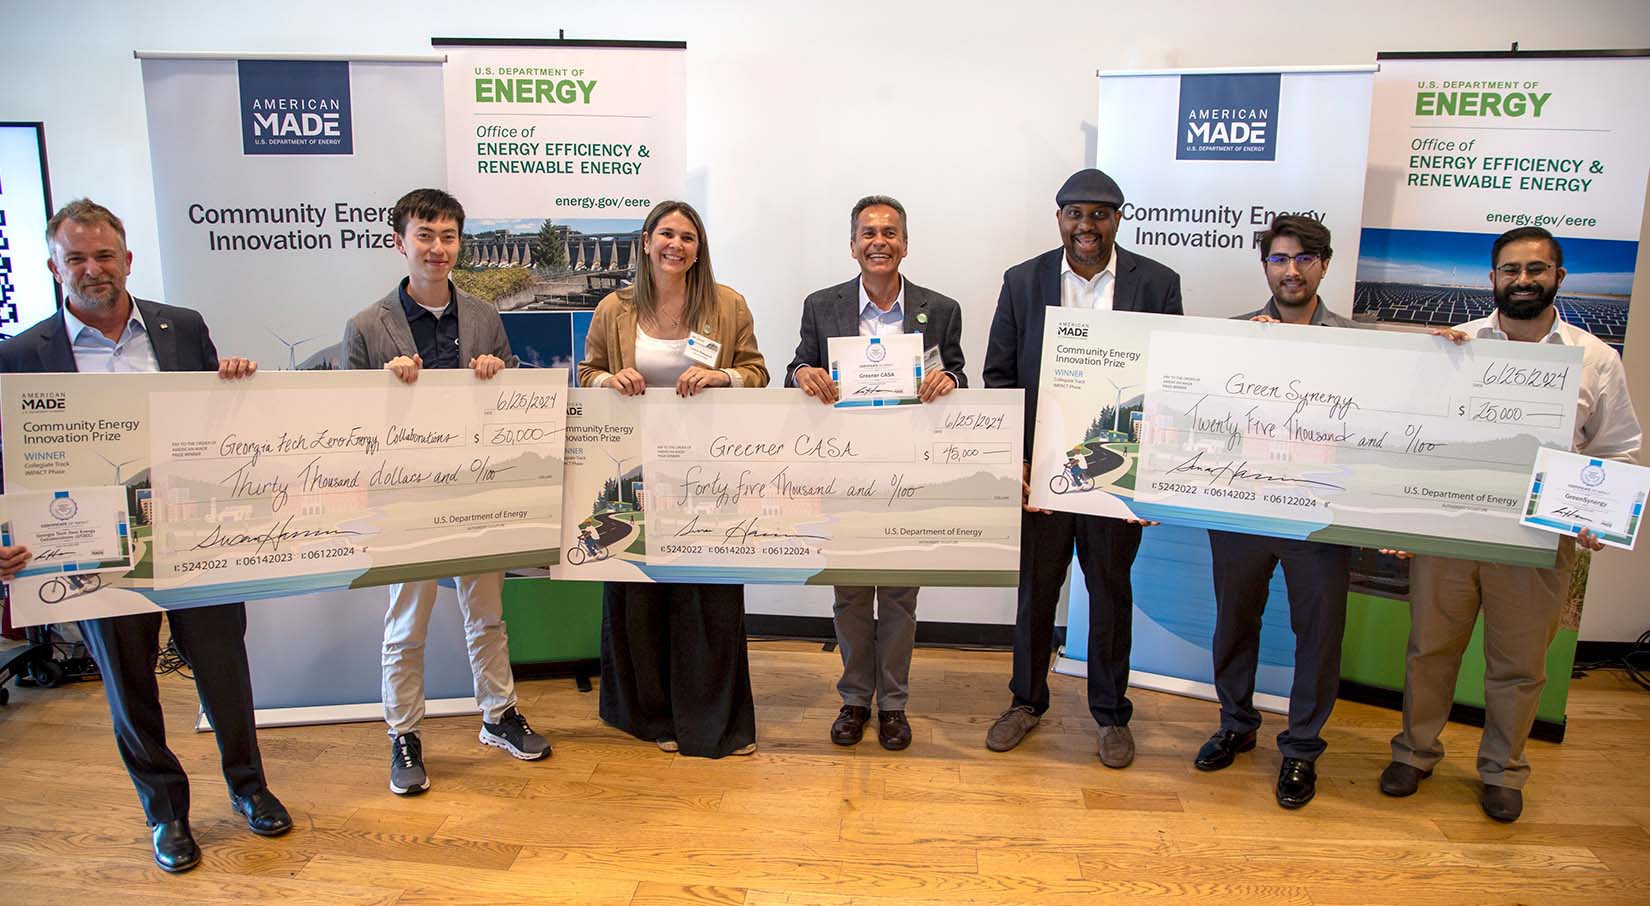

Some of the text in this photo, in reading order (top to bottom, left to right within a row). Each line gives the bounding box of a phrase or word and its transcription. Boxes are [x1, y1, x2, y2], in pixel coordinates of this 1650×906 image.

[475, 68, 585, 77] U.S. DEPARTMENT OF
[475, 78, 598, 104] ENERGY
[1417, 81, 1439, 89] U.S.
[1443, 81, 1519, 89] DEPARTMENT
[253, 99, 340, 110] AMERICAN
[1415, 91, 1552, 117] ENERGY
[1188, 109, 1268, 119] AMERICAN
[254, 113, 340, 136] MADE
[476, 125, 536, 138] Office of
[1187, 122, 1266, 143] MADE
[477, 143, 650, 158] ENERGY EFFICIENCY &
[1411, 138, 1476, 151] Office of
[478, 161, 642, 175] RENEWABLE ENERGY
[1409, 156, 1604, 174] ENERGY EFFICIENCY &
[1407, 174, 1592, 192] RENEWABLE ENERGY
[555, 197, 651, 209] energy.gov/eere
[188, 202, 396, 227] Community Energ
[1121, 203, 1243, 228] Community
[1486, 212, 1597, 227] energy.gov/eere
[209, 230, 395, 250] Innovation Prize
[1135, 227, 1243, 249] Innovation
[1058, 327, 1088, 337] MADE
[1056, 345, 1141, 361] Community Energy
[1056, 354, 1126, 368] Innovation Prize
[1054, 369, 1083, 378] WINNER
[1482, 360, 1569, 391] 6/25/2024
[21, 398, 66, 410] MADE
[497, 390, 557, 414] 6/25/2024
[1225, 373, 1360, 420] Green Synergy
[23, 419, 140, 433] Community Energy
[604, 424, 634, 435] Energy
[1184, 394, 1241, 450] Twenty
[1283, 411, 1355, 442] Thousand
[1357, 431, 1388, 449] and
[24, 432, 121, 444] Innovation Prize
[600, 434, 621, 442] Prize
[219, 433, 274, 467] Georgia
[709, 434, 860, 459] Greener CASA
[24, 451, 66, 461] WINNER
[219, 460, 289, 512] Thirty
[296, 456, 361, 492] Thousand
[433, 464, 462, 483] and
[770, 466, 837, 500] Thousand
[846, 479, 876, 497] and
[1403, 486, 1518, 507] U.S. Department of Energy
[434, 510, 528, 525] U.S. Department of Energy
[884, 527, 983, 537] U.S. Department of Energy
